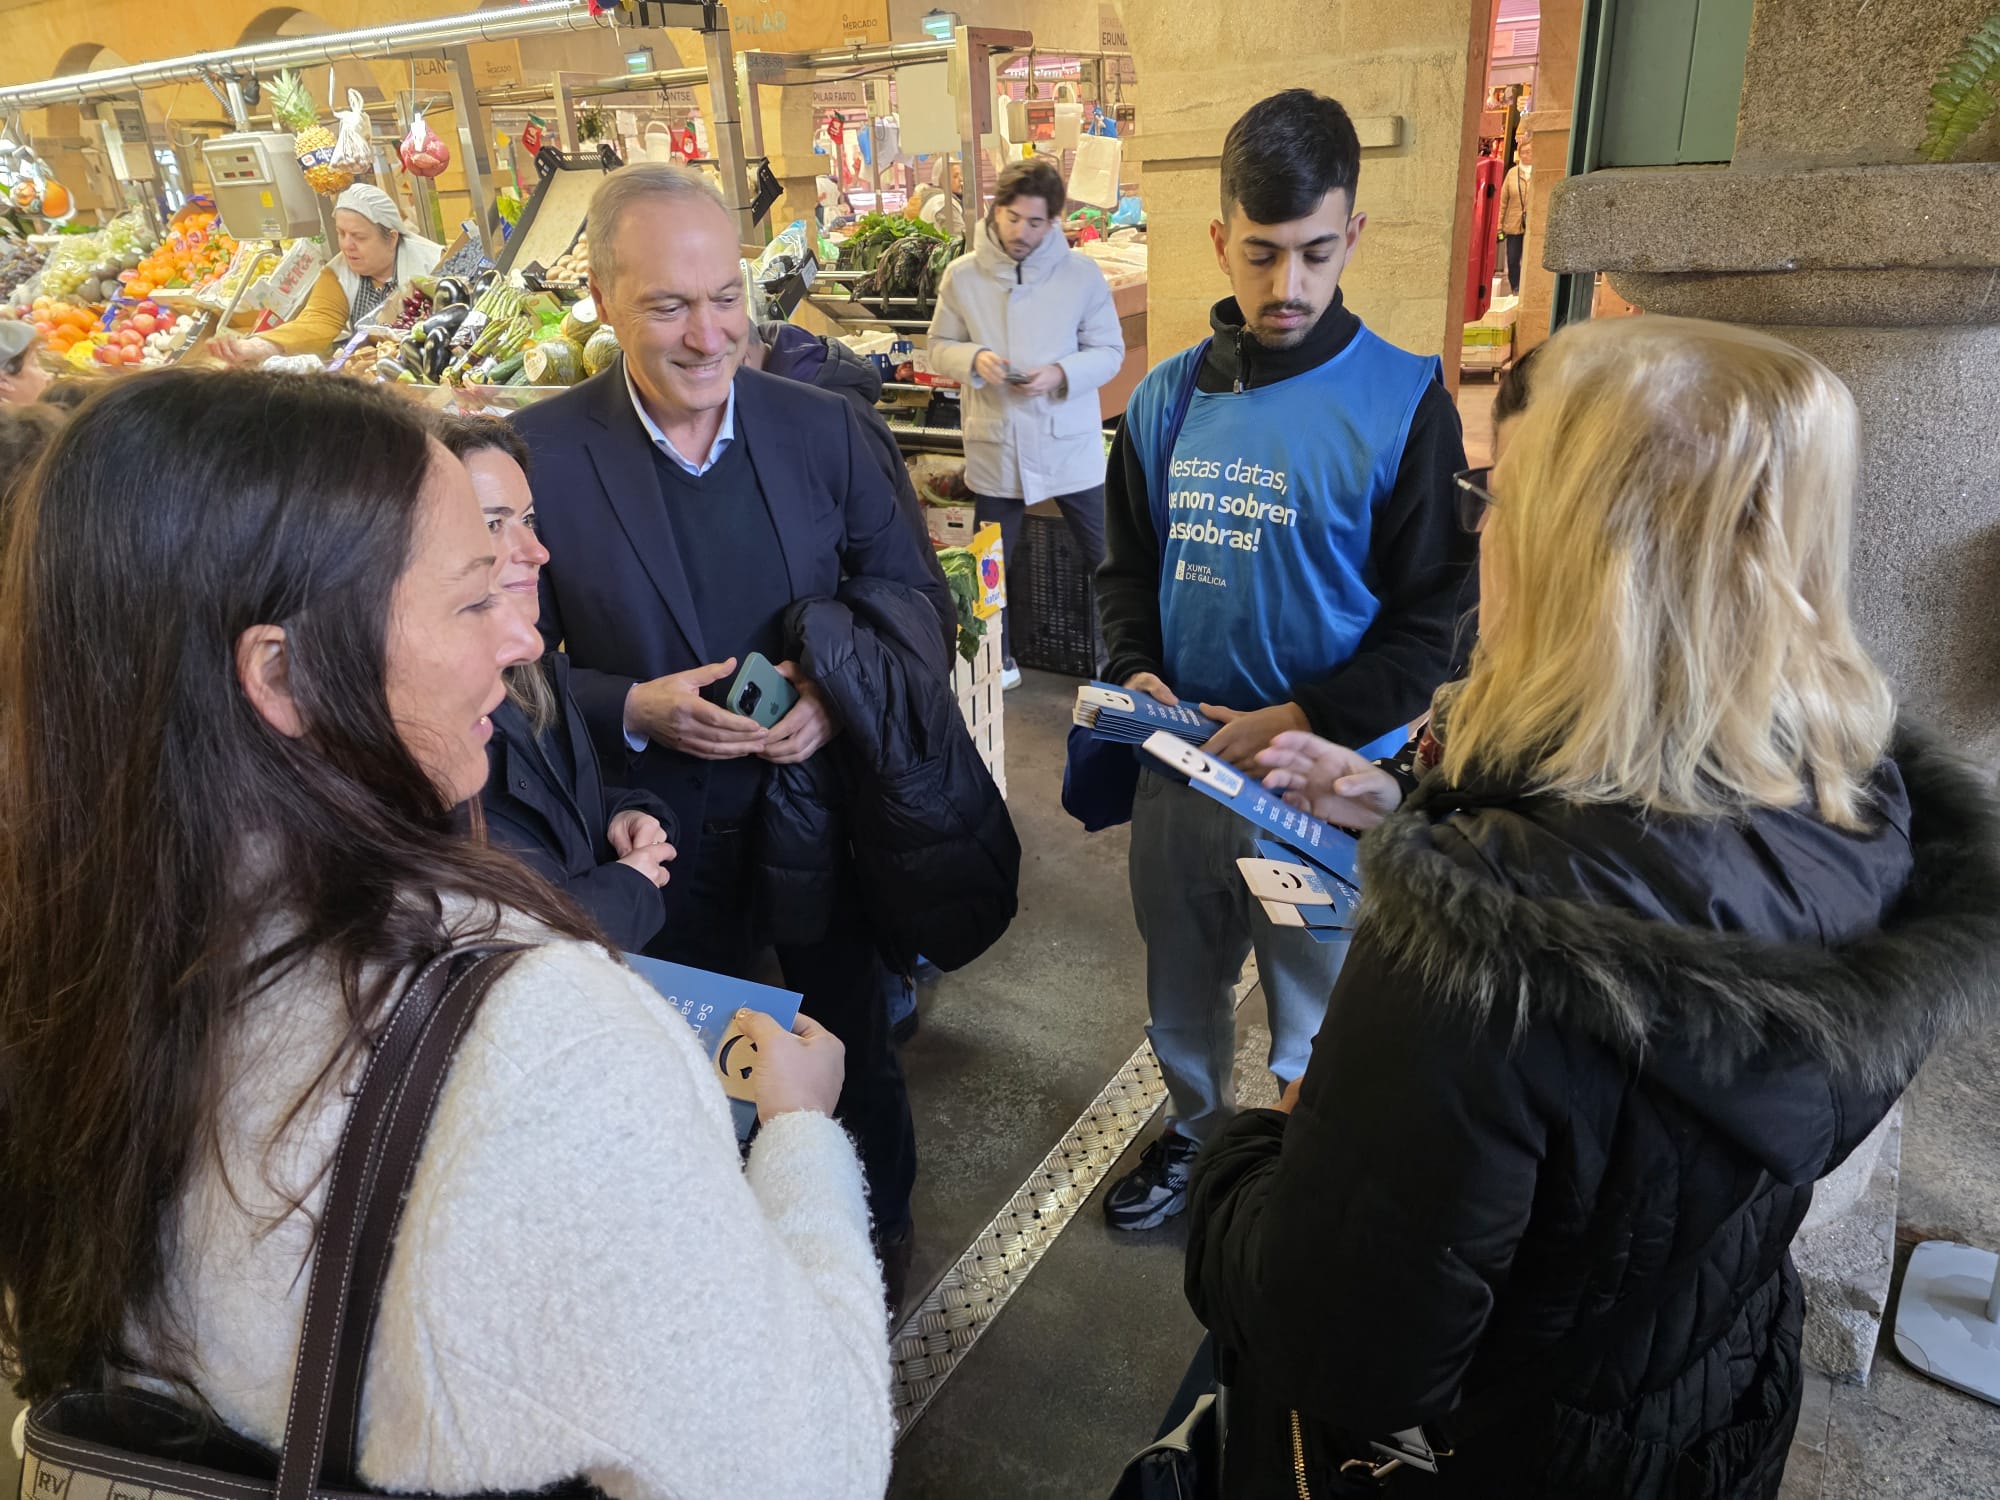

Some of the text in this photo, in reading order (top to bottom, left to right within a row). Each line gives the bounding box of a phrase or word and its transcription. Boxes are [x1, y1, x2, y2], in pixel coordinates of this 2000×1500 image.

[733, 11, 787, 35] PILAR
[842, 19, 878, 30] MERCADO
[1225, 457, 1288, 495] datas,
[1179, 490, 1215, 511] non
[1217, 492, 1298, 528] sobren
[1185, 572, 1227, 588] DE GALICIA
[1187, 563, 1212, 576] XUNTA
[696, 1003, 714, 1021] Se
[39, 1470, 65, 1495] RV
